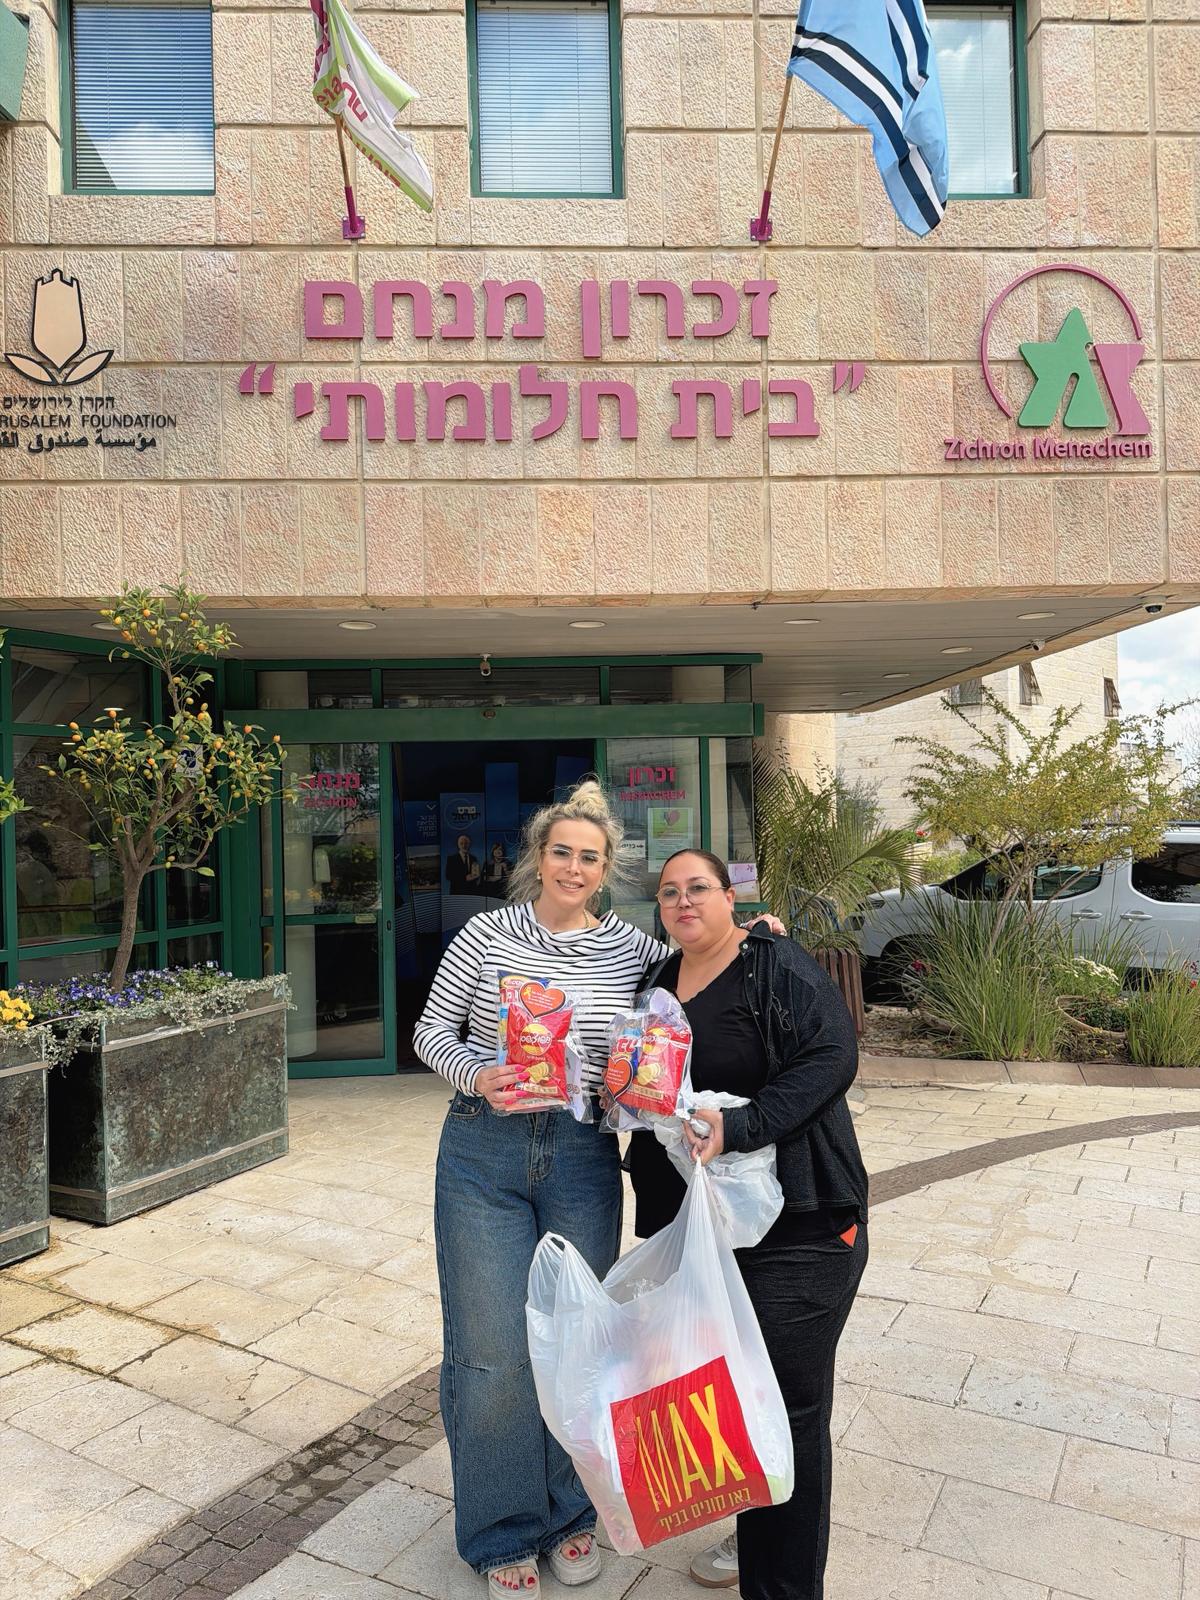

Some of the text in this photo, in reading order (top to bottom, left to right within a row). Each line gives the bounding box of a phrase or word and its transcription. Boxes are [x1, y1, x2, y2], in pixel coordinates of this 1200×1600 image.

[304, 279, 778, 358] זכרון מנחם
[3, 394, 116, 412] הקרן לירושלים
[81, 414, 177, 429] FOUNDATION
[27, 432, 89, 453] صندوق
[95, 429, 157, 452] مؤسسة
[944, 436, 1153, 461] Zichron Menachem
[629, 767, 677, 788] זכרון
[636, 1383, 746, 1513] MAX
[660, 1487, 751, 1533] באו קונים בכיף
